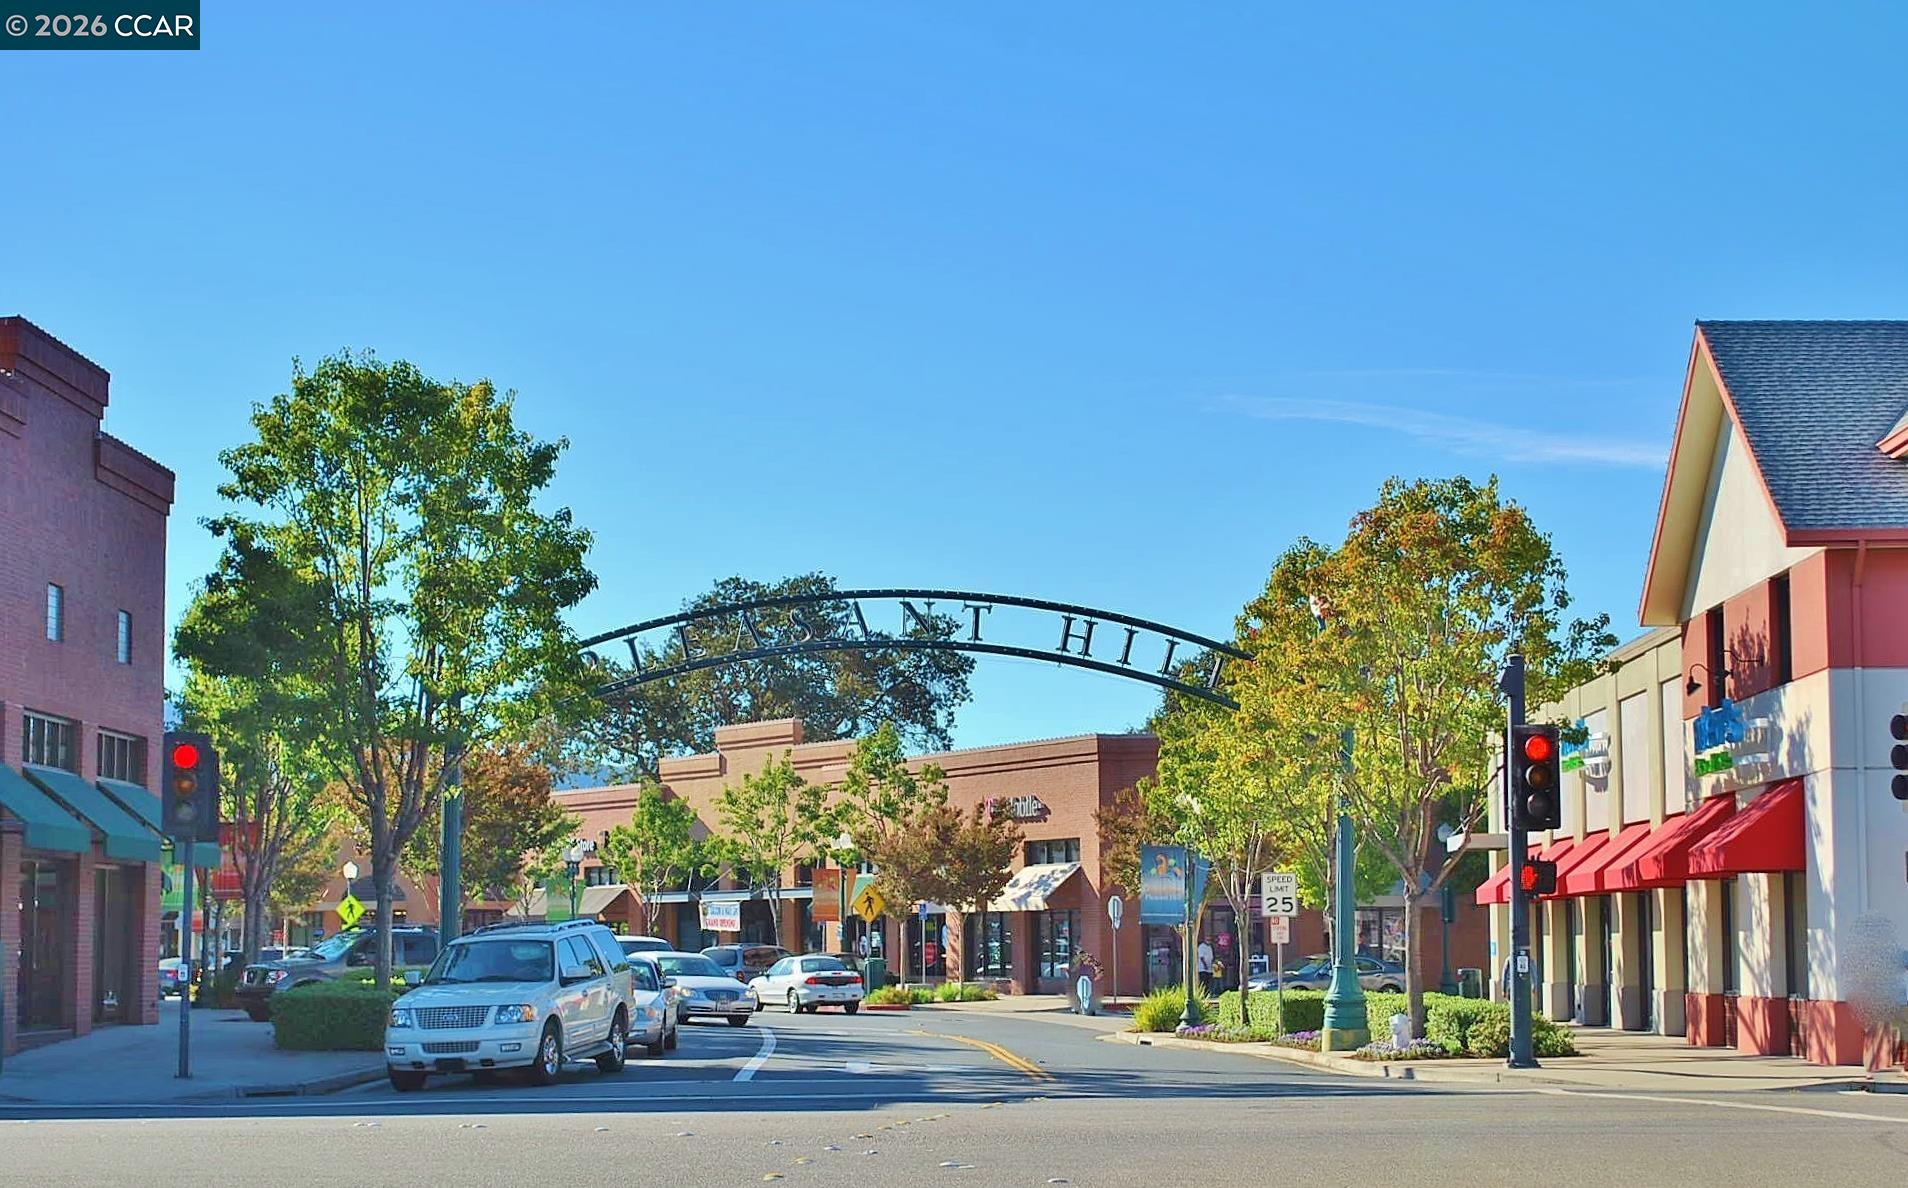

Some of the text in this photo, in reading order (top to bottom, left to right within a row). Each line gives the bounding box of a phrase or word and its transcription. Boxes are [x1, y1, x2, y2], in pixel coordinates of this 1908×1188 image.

[1266, 875, 1293, 883] SPEED
[1269, 885, 1289, 893] LIMIT
[1266, 896, 1294, 913] 25
